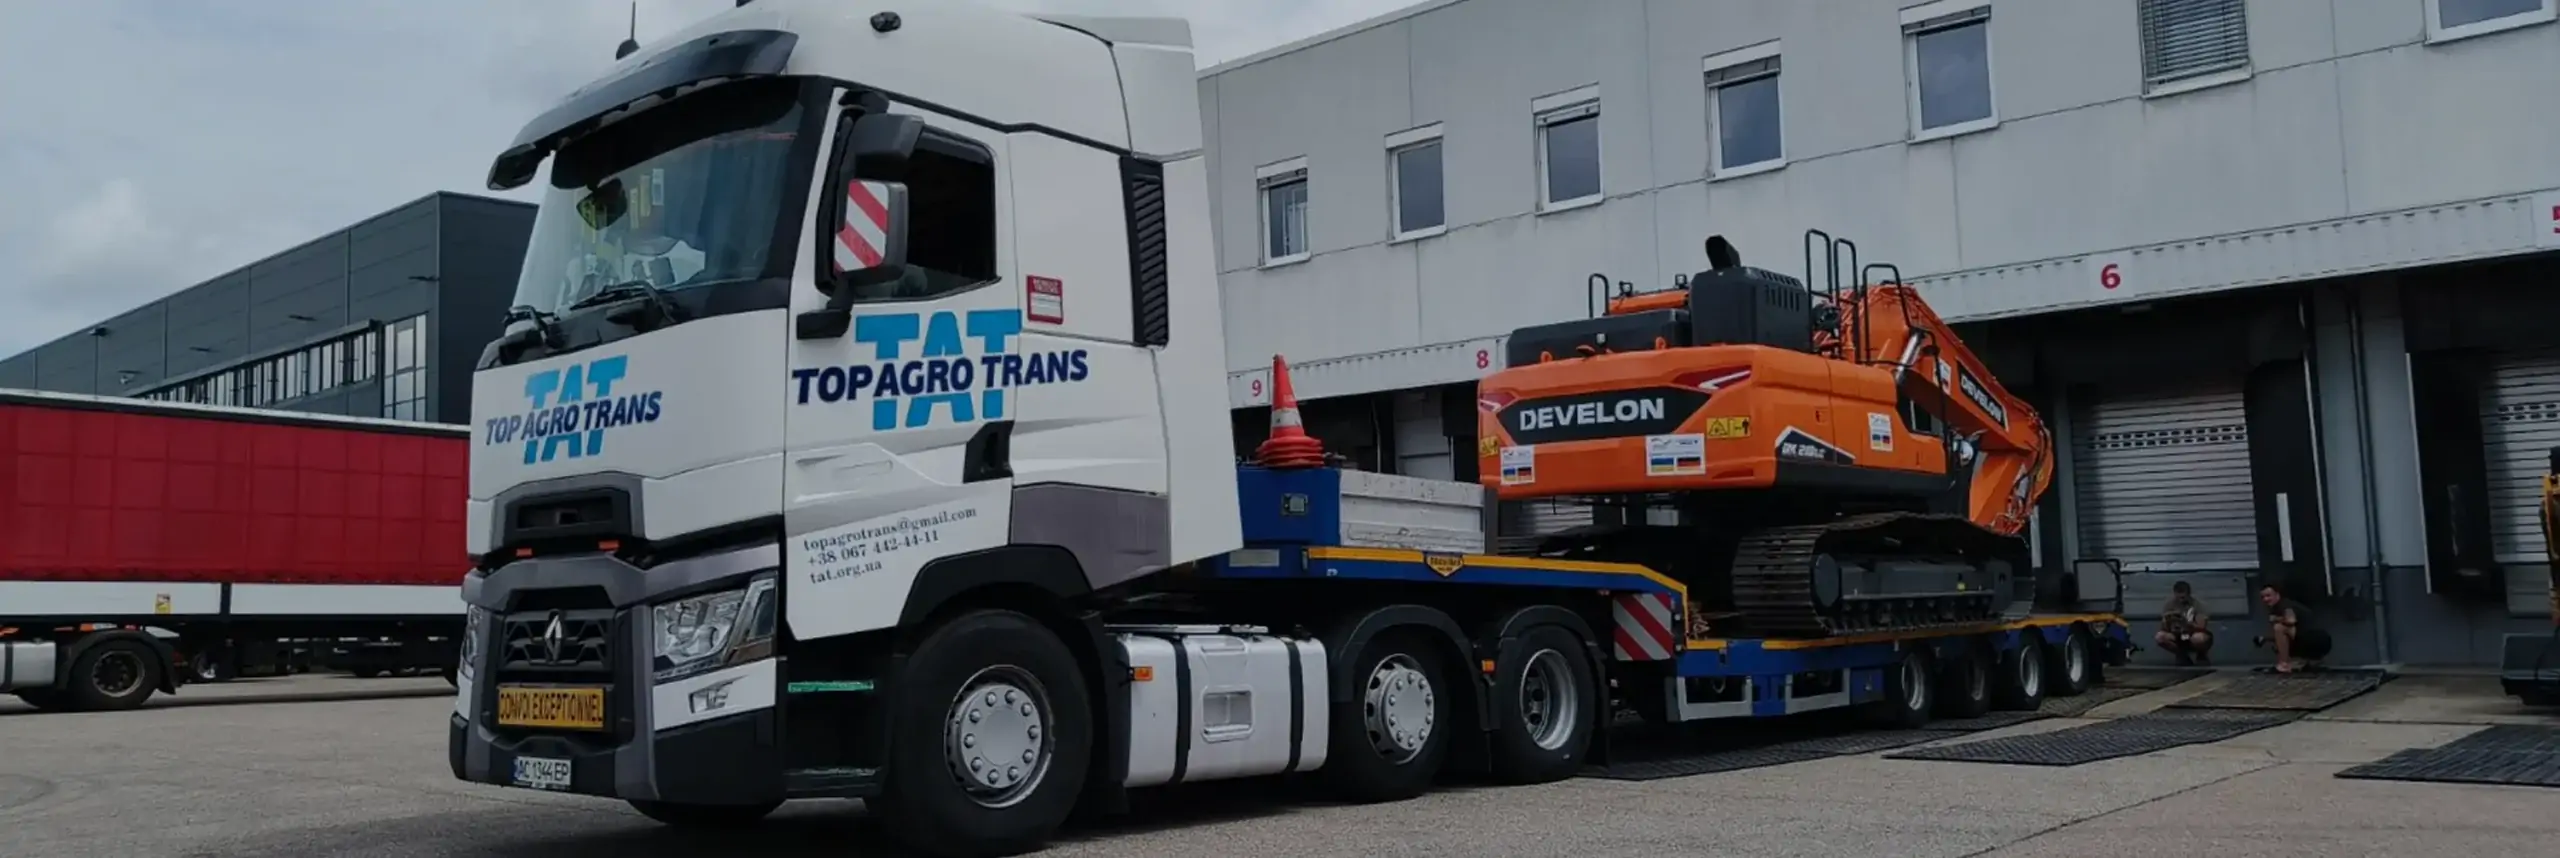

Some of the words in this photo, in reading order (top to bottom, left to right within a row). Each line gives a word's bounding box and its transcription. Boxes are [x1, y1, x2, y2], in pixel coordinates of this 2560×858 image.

[2100, 263, 2121, 289] 6
[792, 365, 873, 405] TOP
[873, 358, 974, 398] AGRO
[981, 349, 1088, 388] TRANS
[855, 309, 1022, 431] TAT
[1476, 351, 1488, 369] 8
[1252, 379, 1262, 397] 9
[486, 414, 522, 446] TOP
[521, 404, 580, 441] AGRO
[584, 391, 663, 430] TRANS
[524, 355, 628, 465] TAT
[1519, 398, 1665, 431] DEVELON
[803, 507, 977, 551] topagrotrans@gmail.com
[808, 551, 837, 567] +38
[841, 544, 866, 561] 067
[873, 530, 939, 554] 442-44-11
[810, 560, 883, 585] tat.org.ua
